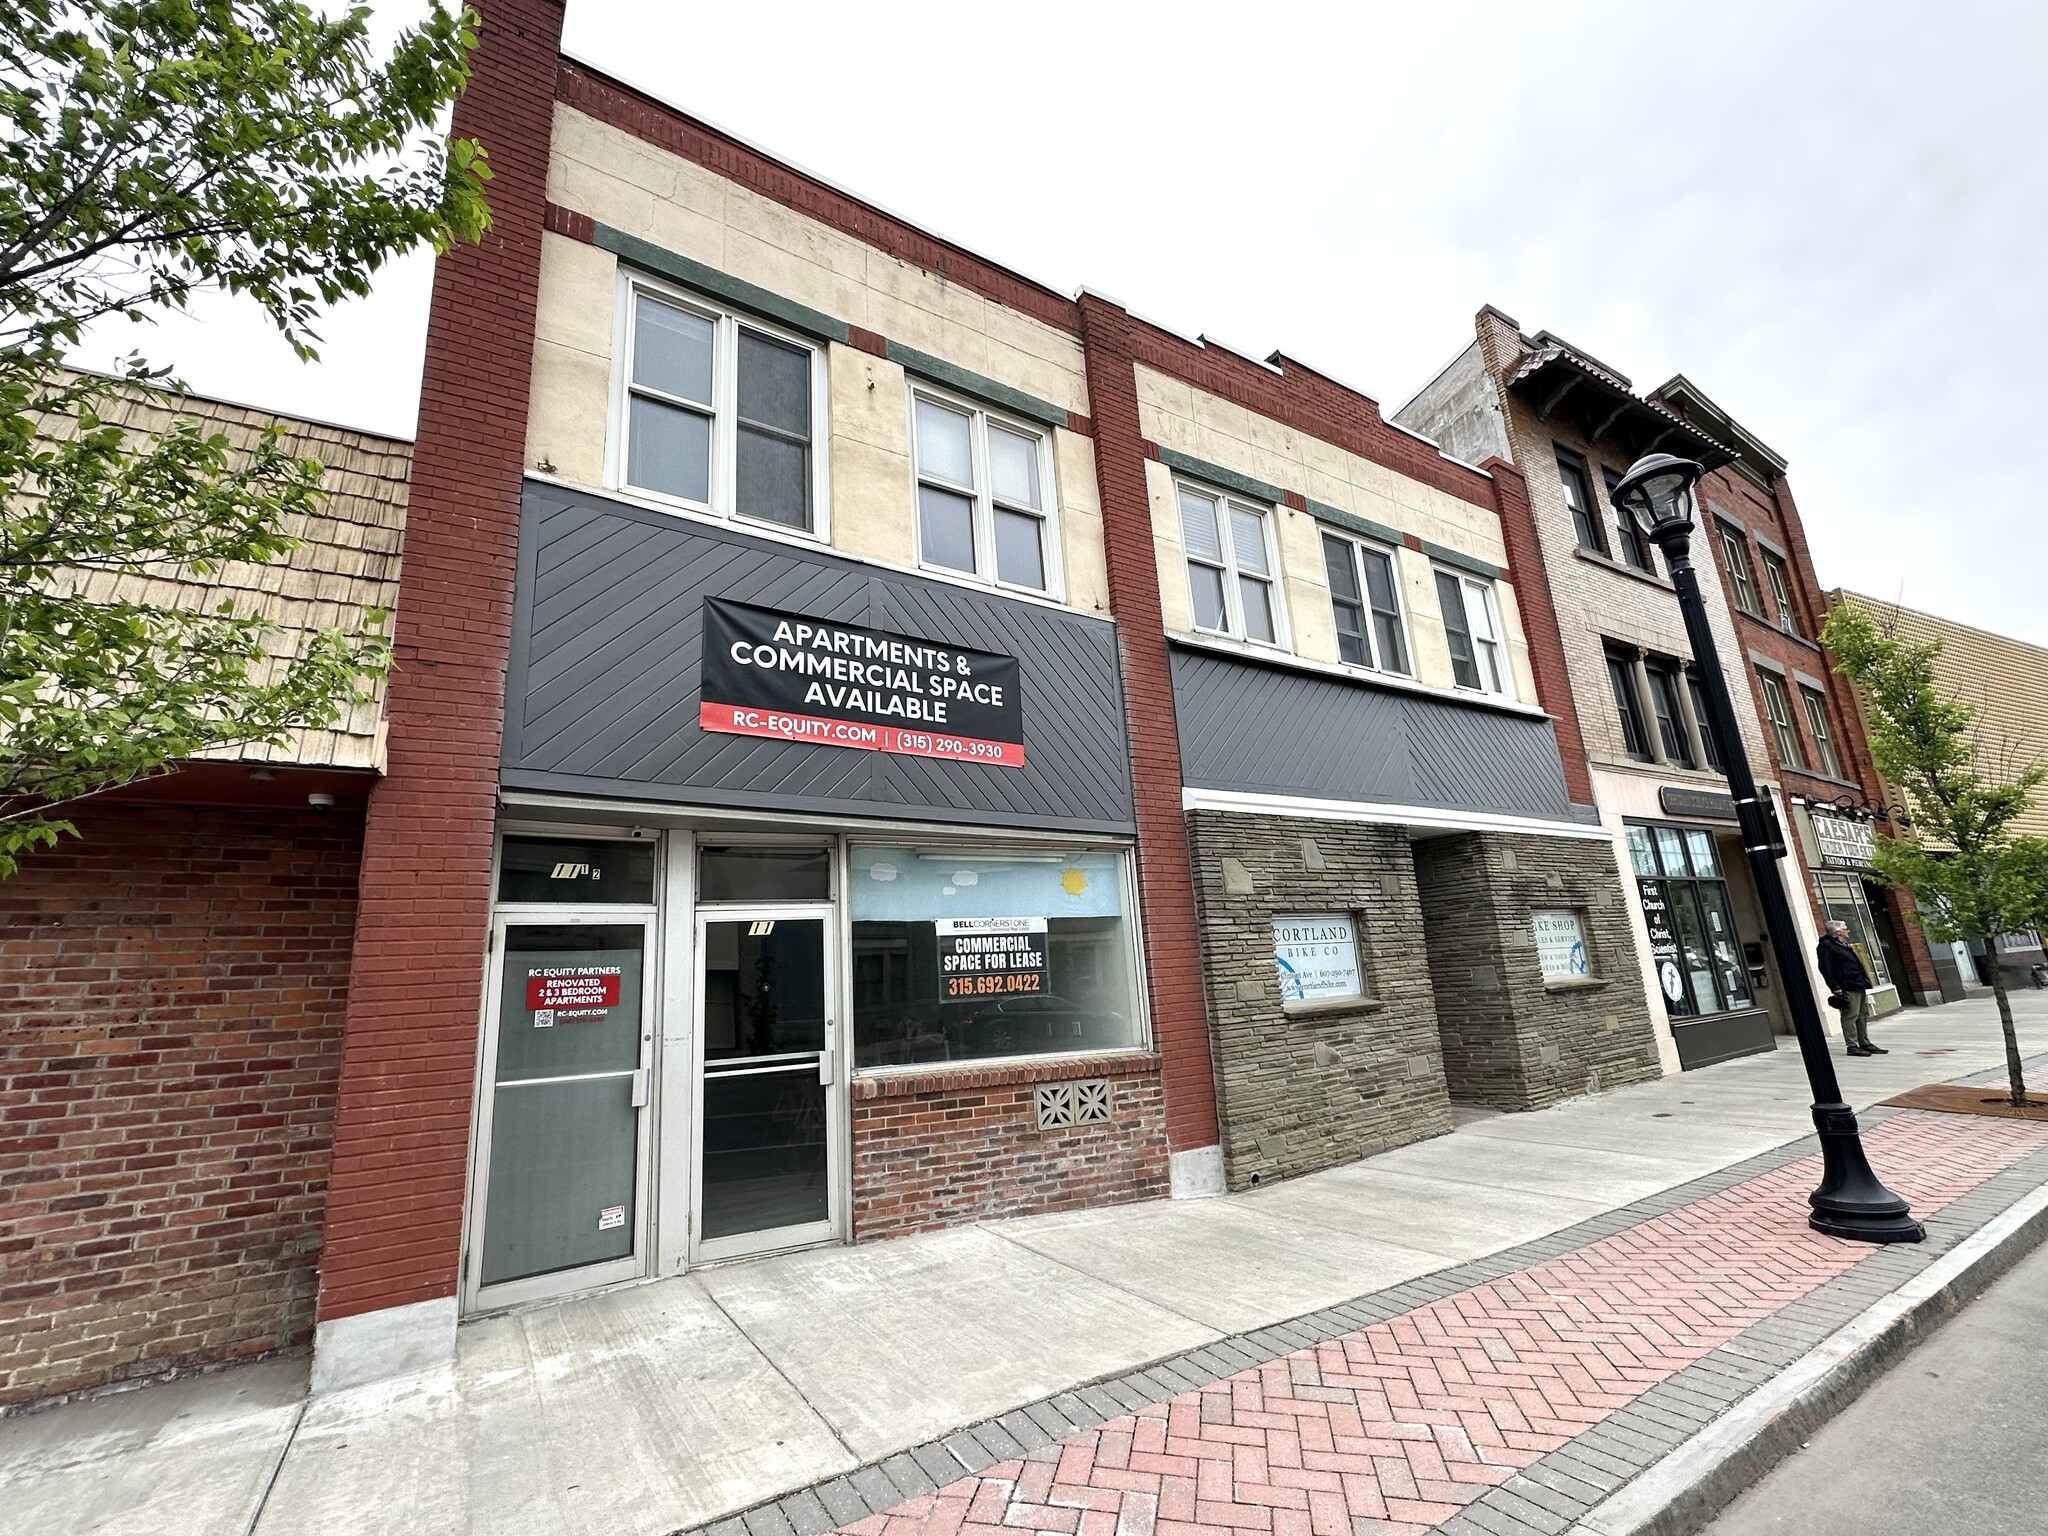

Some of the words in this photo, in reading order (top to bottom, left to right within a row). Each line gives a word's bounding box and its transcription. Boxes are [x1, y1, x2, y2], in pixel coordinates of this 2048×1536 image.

[773, 621, 951, 671] APARTMENTS
[956, 656, 971, 676] &
[731, 641, 923, 693] COMMERCIAL
[929, 675, 1003, 707] SPACE
[804, 682, 947, 723] AVAILABLE
[733, 710, 876, 742] RC-EQUITY.COM
[897, 733, 932, 753] (315)
[936, 739, 1002, 758] 290-3930
[1814, 817, 1873, 844] CAESAR'S
[1825, 856, 1845, 866] TATTOO
[1643, 885, 1658, 896] First
[1643, 899, 1665, 910] Church
[1654, 913, 1661, 925] of
[1552, 920, 1574, 930] SHOP
[1273, 927, 1347, 941] CORTLAND
[1650, 928, 1671, 940] Christ,
[955, 936, 1031, 953] COMMERCIAL
[1651, 943, 1678, 954] Scientist
[1288, 947, 1316, 957] BIKE
[1324, 946, 1338, 955] CO
[944, 954, 981, 971] SPACE
[985, 953, 1006, 970] FOR
[1010, 952, 1042, 968] LEASE
[528, 969, 541, 977] RC
[544, 968, 576, 978] EQUITY
[577, 967, 621, 975] PARTNERS
[1302, 971, 1312, 979] Ave
[546, 978, 600, 988] RENOVATED
[949, 974, 1039, 996] 315.692.0422
[538, 989, 544, 997] 2
[546, 989, 552, 997] &
[554, 988, 560, 996] 3
[562, 987, 607, 996] BEDROOM
[544, 995, 603, 1005] APARTMENTS
[557, 1009, 608, 1017] RC-EQUITY.COM
